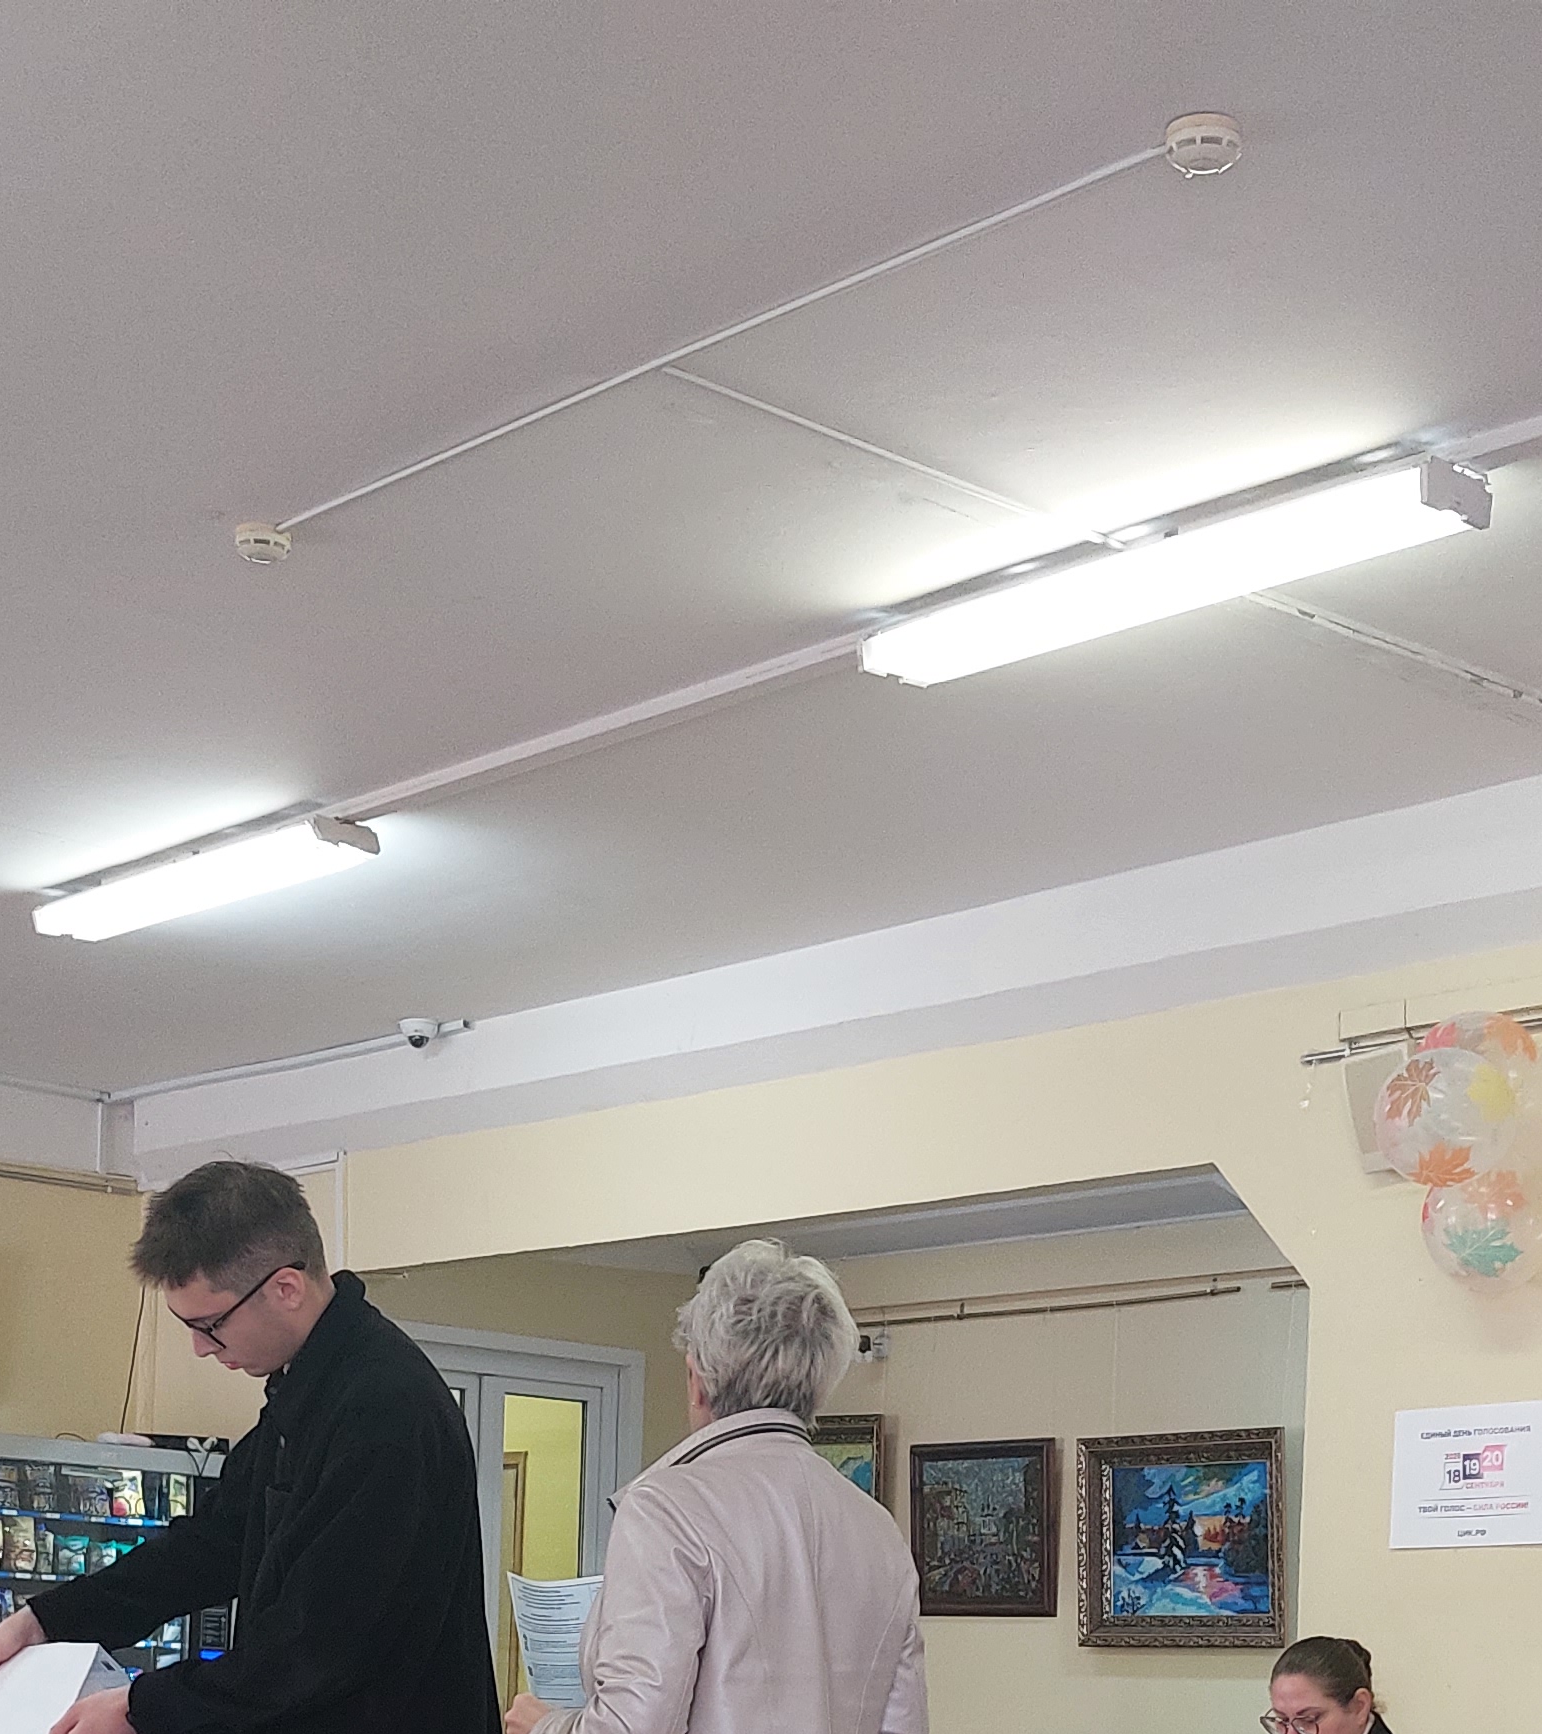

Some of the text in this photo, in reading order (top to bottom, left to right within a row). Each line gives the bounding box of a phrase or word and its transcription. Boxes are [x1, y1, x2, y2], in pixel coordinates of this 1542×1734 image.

[1474, 1425, 1531, 1436] ГОЛОСОВАНИЯ
[1446, 1451, 1503, 1484] 18 19 20
